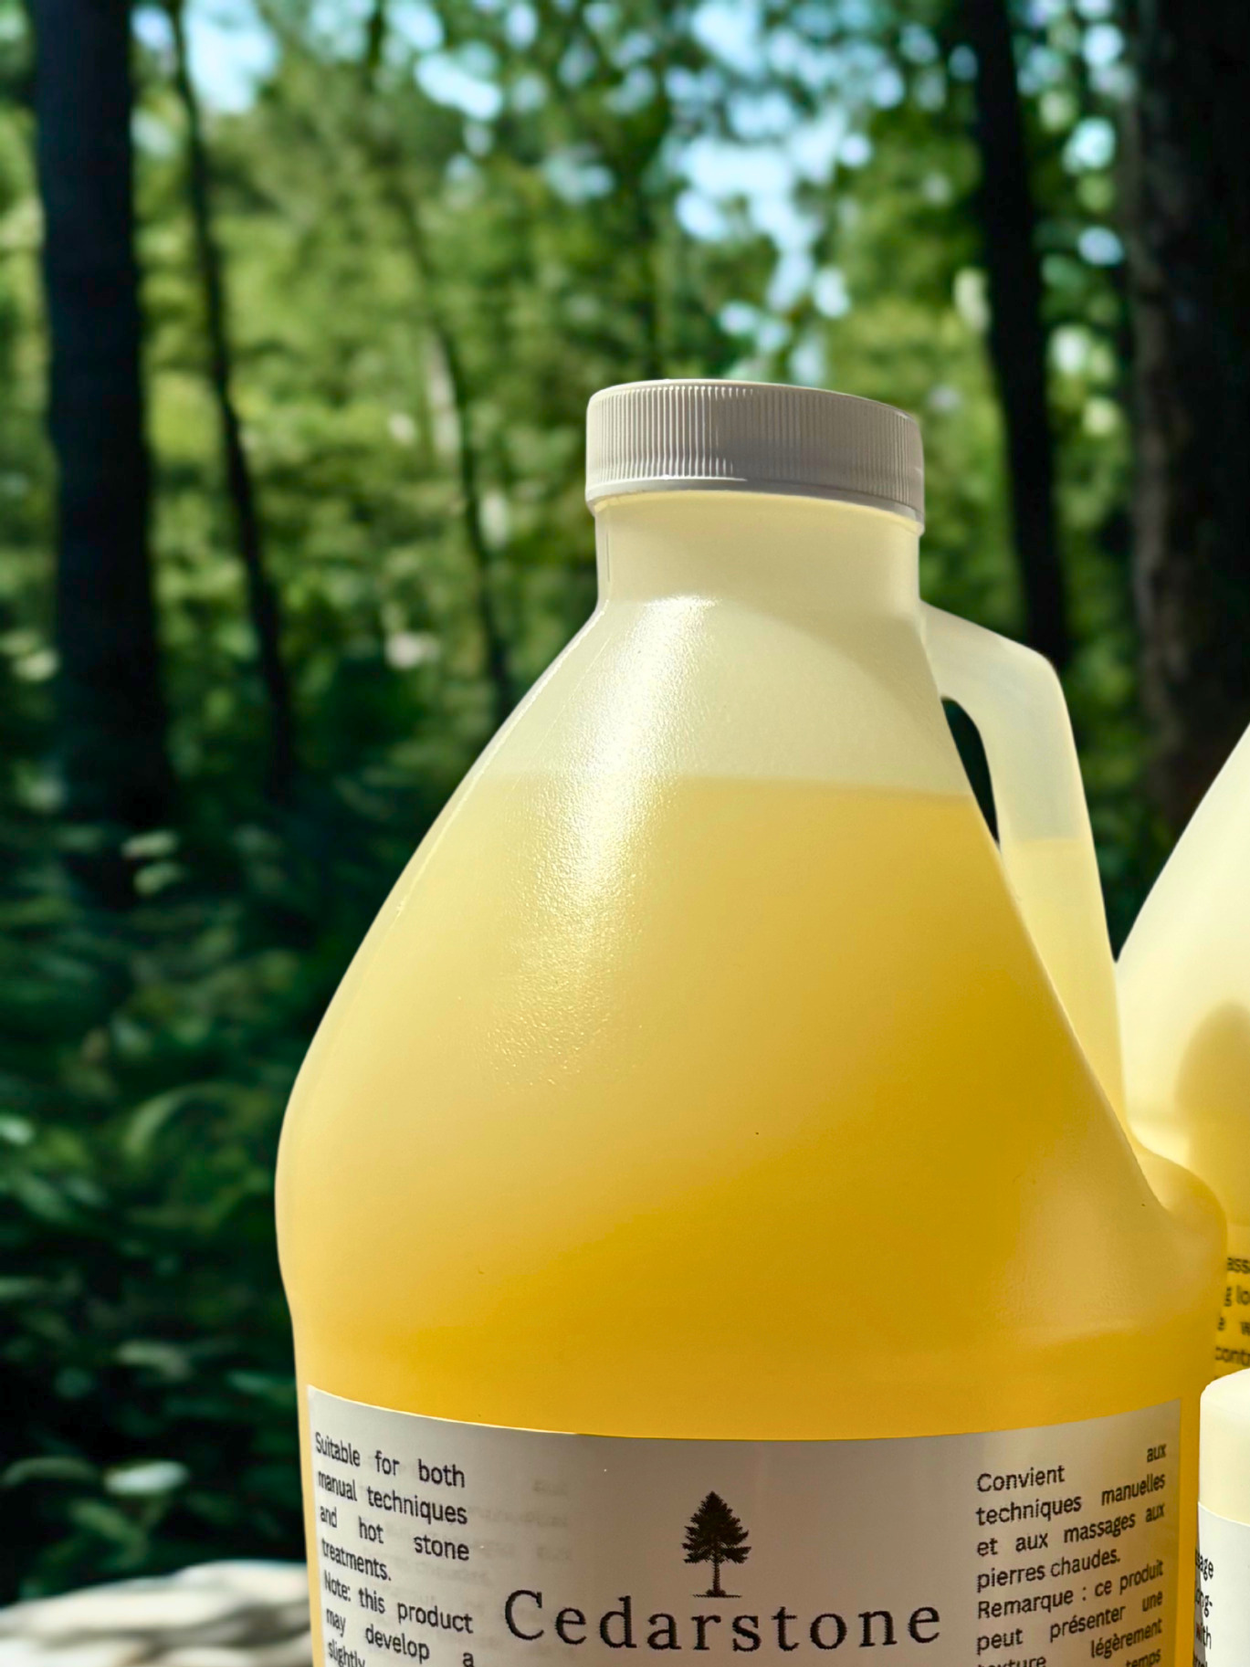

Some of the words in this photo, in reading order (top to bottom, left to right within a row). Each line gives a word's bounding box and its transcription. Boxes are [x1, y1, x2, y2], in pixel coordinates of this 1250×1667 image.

[315, 1432, 360, 1467] Suitable
[376, 1450, 400, 1476] for
[418, 1459, 465, 1488] both
[977, 1465, 1065, 1492] Convient
[1147, 1444, 1166, 1463] aux
[318, 1470, 357, 1502] manual
[367, 1486, 468, 1525] techniques
[976, 1496, 1082, 1526] techniques
[1102, 1474, 1165, 1506] manuelles
[320, 1506, 337, 1528] and
[359, 1516, 384, 1544] hot
[414, 1534, 469, 1561] stone
[977, 1538, 998, 1556] et
[1016, 1532, 1048, 1552] aux
[1064, 1513, 1135, 1544] massages
[1146, 1503, 1164, 1522] aux
[322, 1538, 391, 1581] treatments.
[976, 1563, 1046, 1592] pierres
[1050, 1548, 1120, 1578] chaudes.
[324, 1572, 351, 1602] Note:
[358, 1588, 385, 1614] this
[397, 1601, 472, 1634] product
[978, 1589, 1074, 1620] Remarque
[1095, 1579, 1112, 1597] ce
[1120, 1560, 1163, 1595] produit
[326, 1607, 346, 1636] may
[366, 1624, 430, 1662] develop
[463, 1652, 474, 1667] a
[505, 1589, 940, 1652] Cedarstone
[976, 1628, 1023, 1656] peut
[1050, 1605, 1125, 1640] présenter
[1142, 1591, 1162, 1612] une
[1091, 1619, 1162, 1658] légèrement
